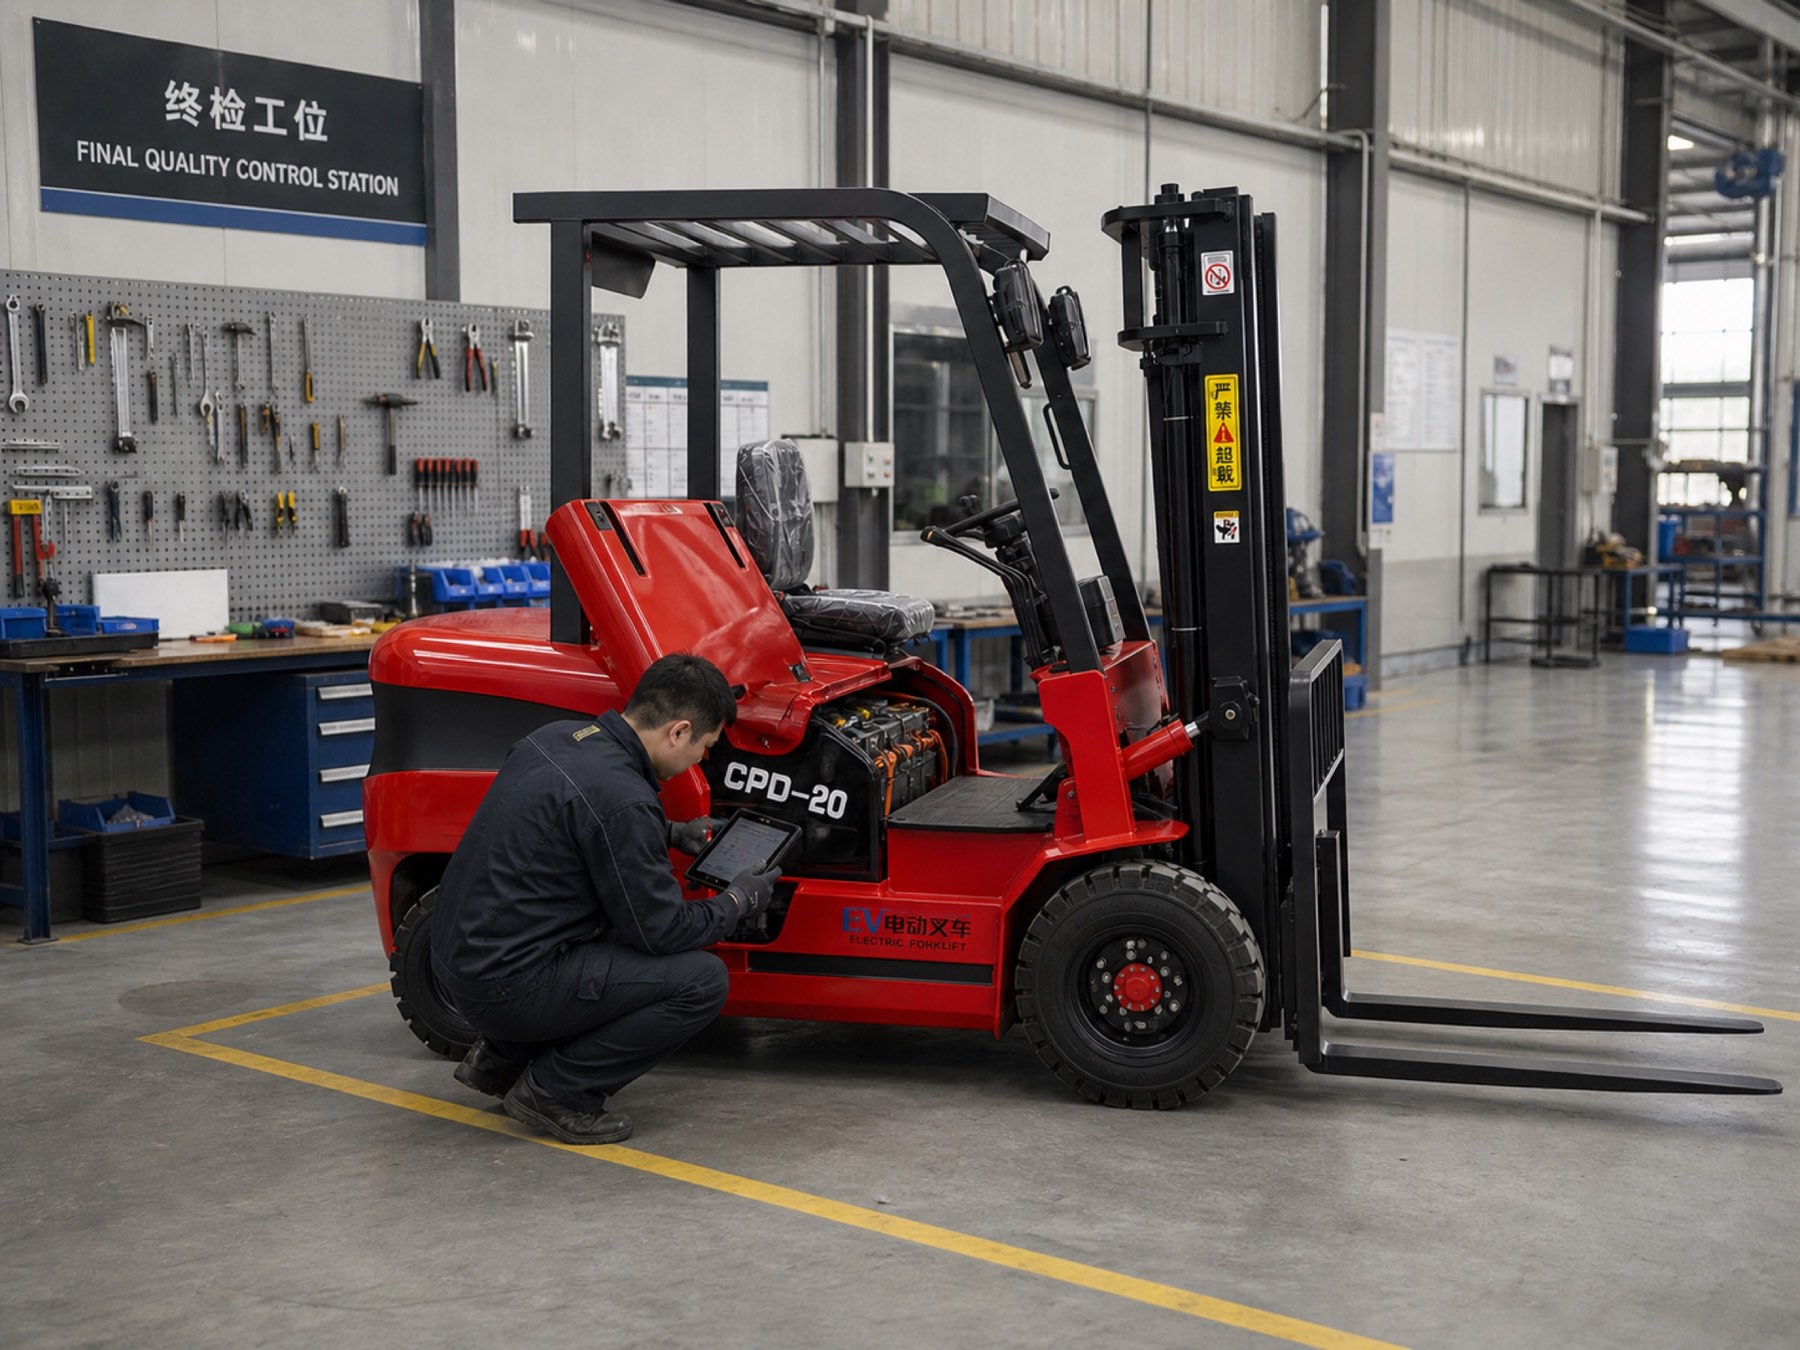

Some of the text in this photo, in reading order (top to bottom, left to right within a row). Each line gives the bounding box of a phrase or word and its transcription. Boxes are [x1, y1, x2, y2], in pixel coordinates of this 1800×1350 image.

[164, 80, 328, 142] 终检工位
[77, 140, 399, 196] FINAL QUALITY CONTROL STATION
[724, 761, 848, 820] CPD-20
[843, 906, 972, 939] EV 电动叉车
[849, 935, 904, 948] ELECTRIC
